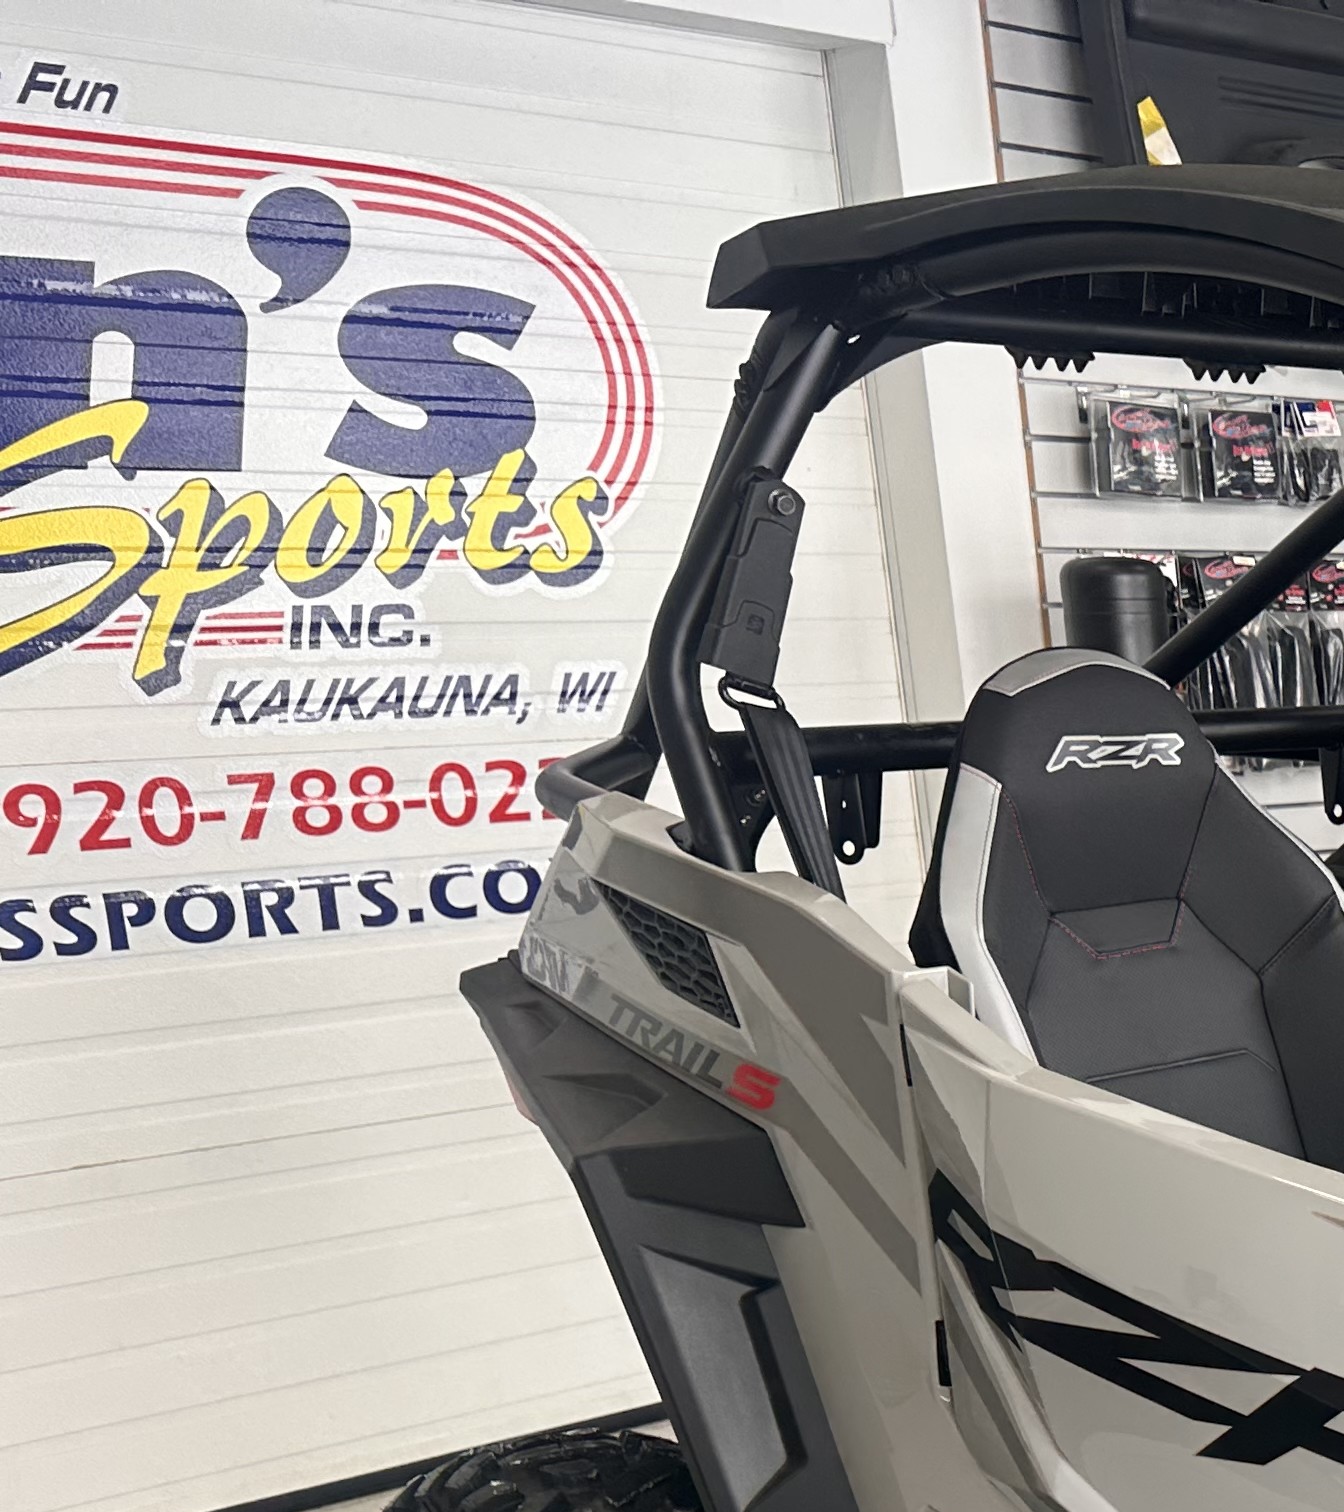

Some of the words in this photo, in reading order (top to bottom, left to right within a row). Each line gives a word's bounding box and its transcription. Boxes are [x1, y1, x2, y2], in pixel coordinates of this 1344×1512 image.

[16, 61, 119, 114] Fun
[0, 398, 611, 695] Sports
[289, 603, 431, 650] INC.
[210, 673, 533, 726] KAUKAUNA,
[556, 671, 617, 713] WI
[1046, 732, 1184, 773] RZR
[0, 858, 545, 962] SSPORTS.CO
[608, 994, 723, 1090] TRAIL
[726, 1063, 782, 1111] S
